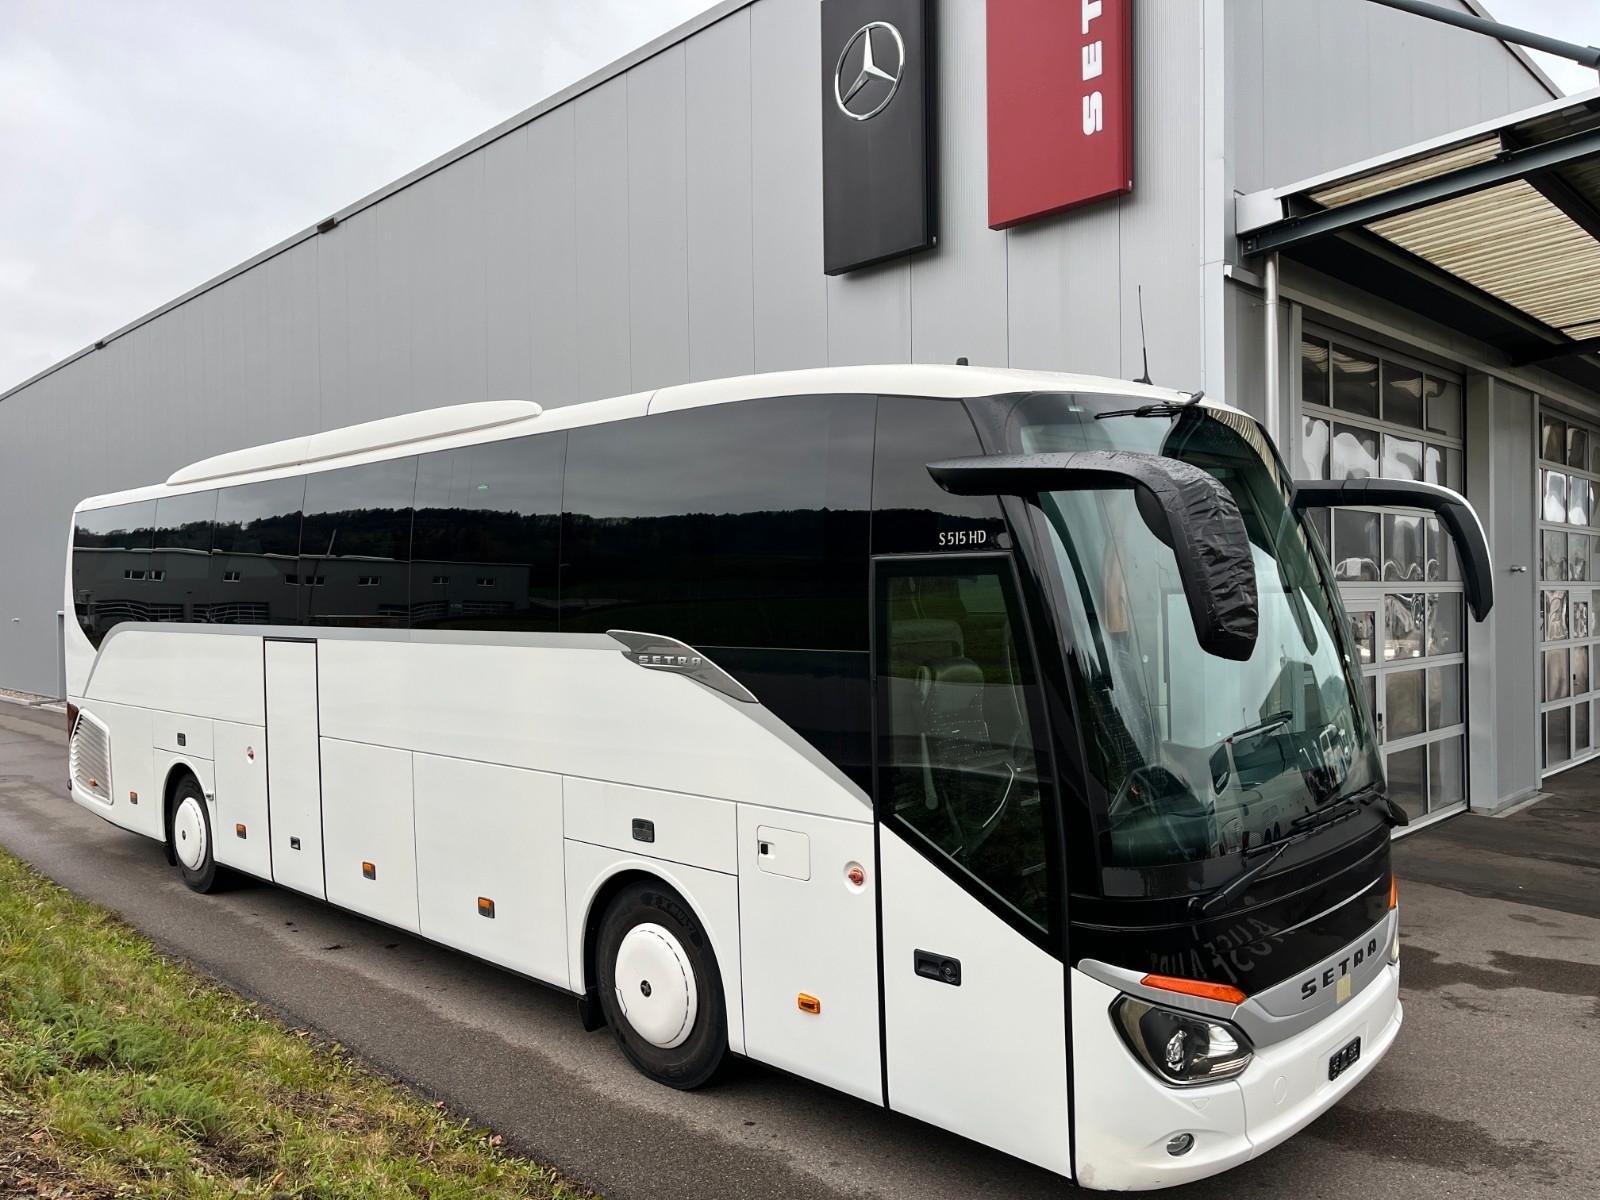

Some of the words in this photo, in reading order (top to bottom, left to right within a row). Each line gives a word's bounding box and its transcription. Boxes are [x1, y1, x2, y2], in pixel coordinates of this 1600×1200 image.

[938, 532, 946, 546] S
[947, 531, 967, 545] 515
[969, 529, 987, 544] HD
[638, 655, 702, 665] SETRA
[1301, 938, 1377, 1000] SETRA
